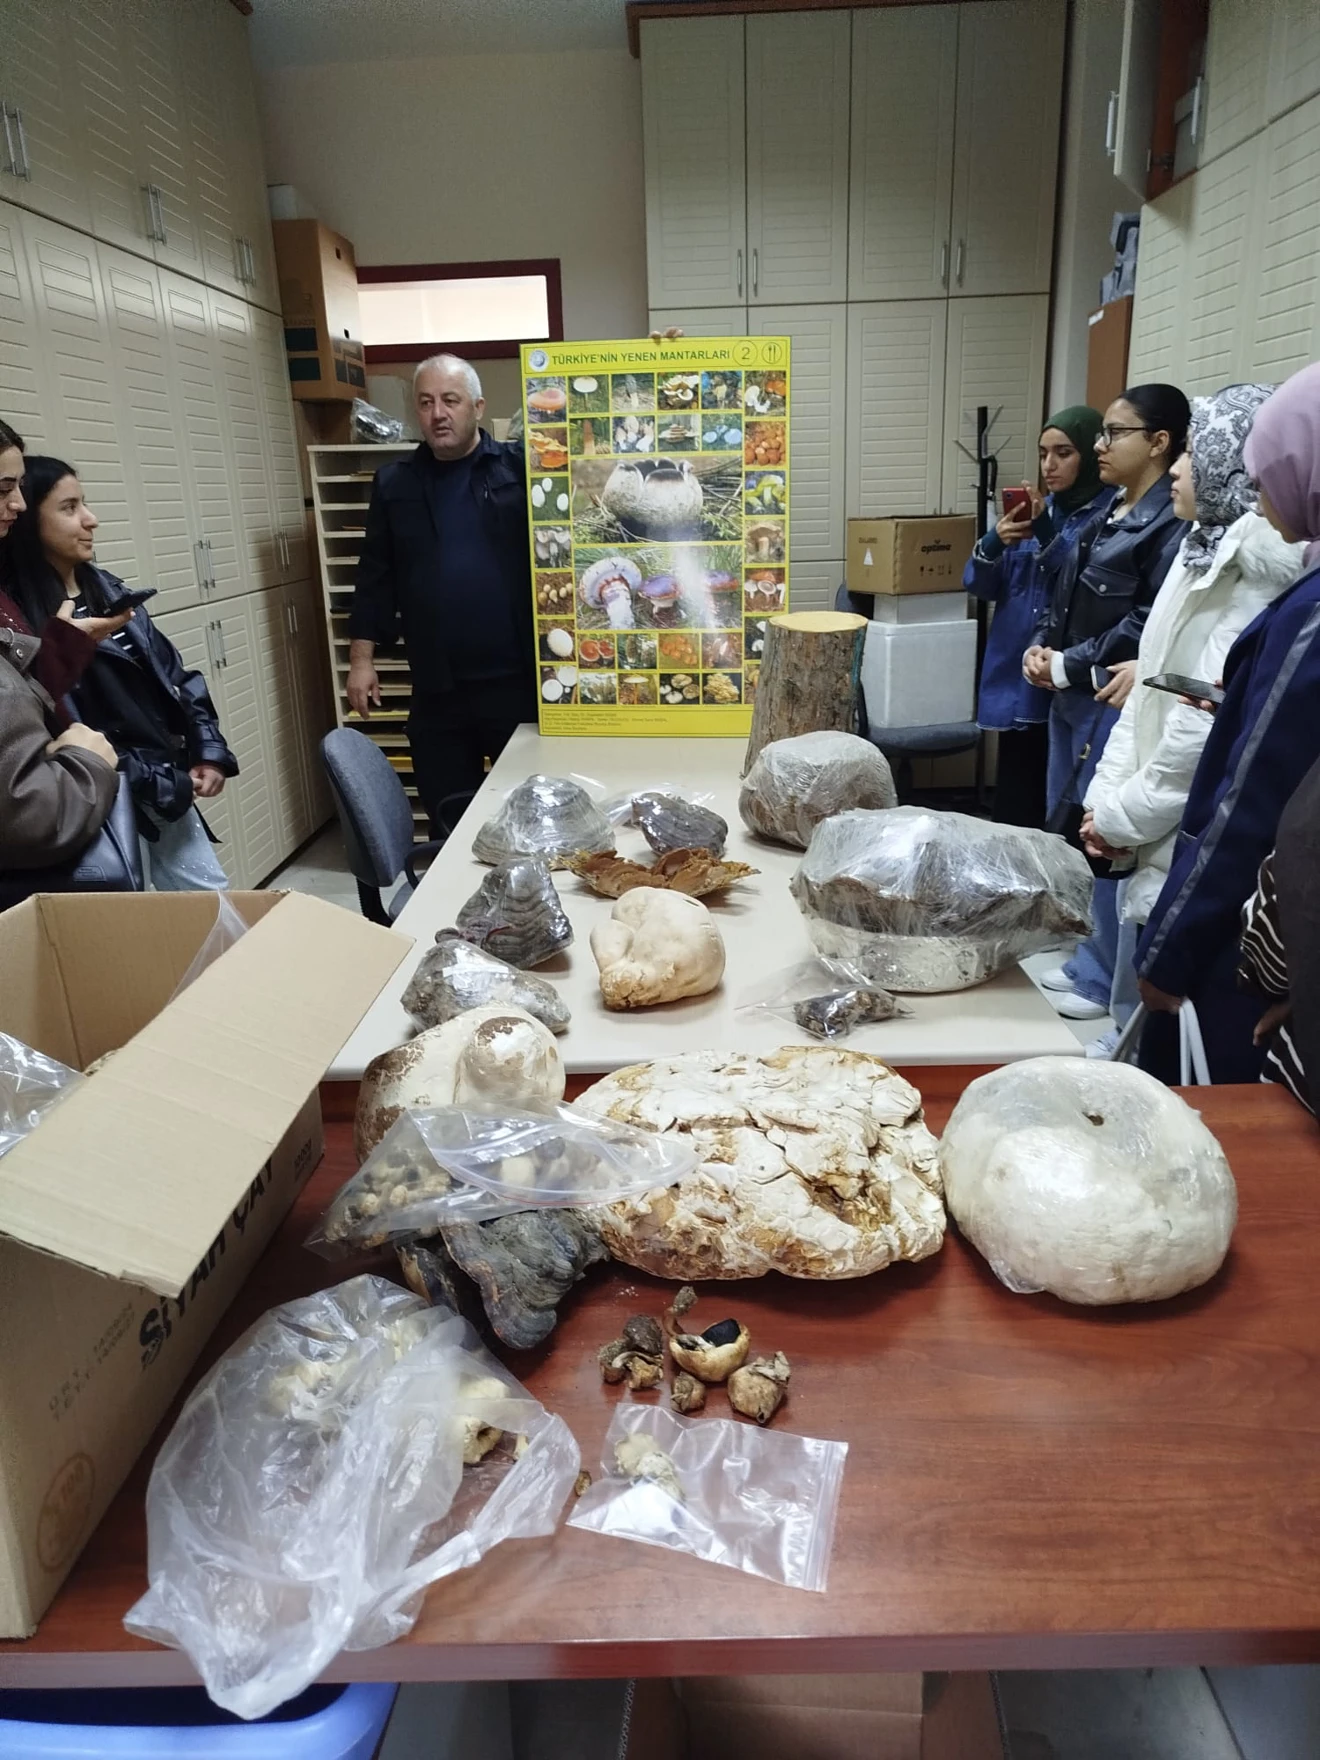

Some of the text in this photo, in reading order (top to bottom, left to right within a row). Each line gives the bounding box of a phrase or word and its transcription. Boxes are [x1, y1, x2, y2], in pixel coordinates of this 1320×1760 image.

[552, 346, 751, 365] TÜRKİYE'NİN YENEN MANTARLARI 2
